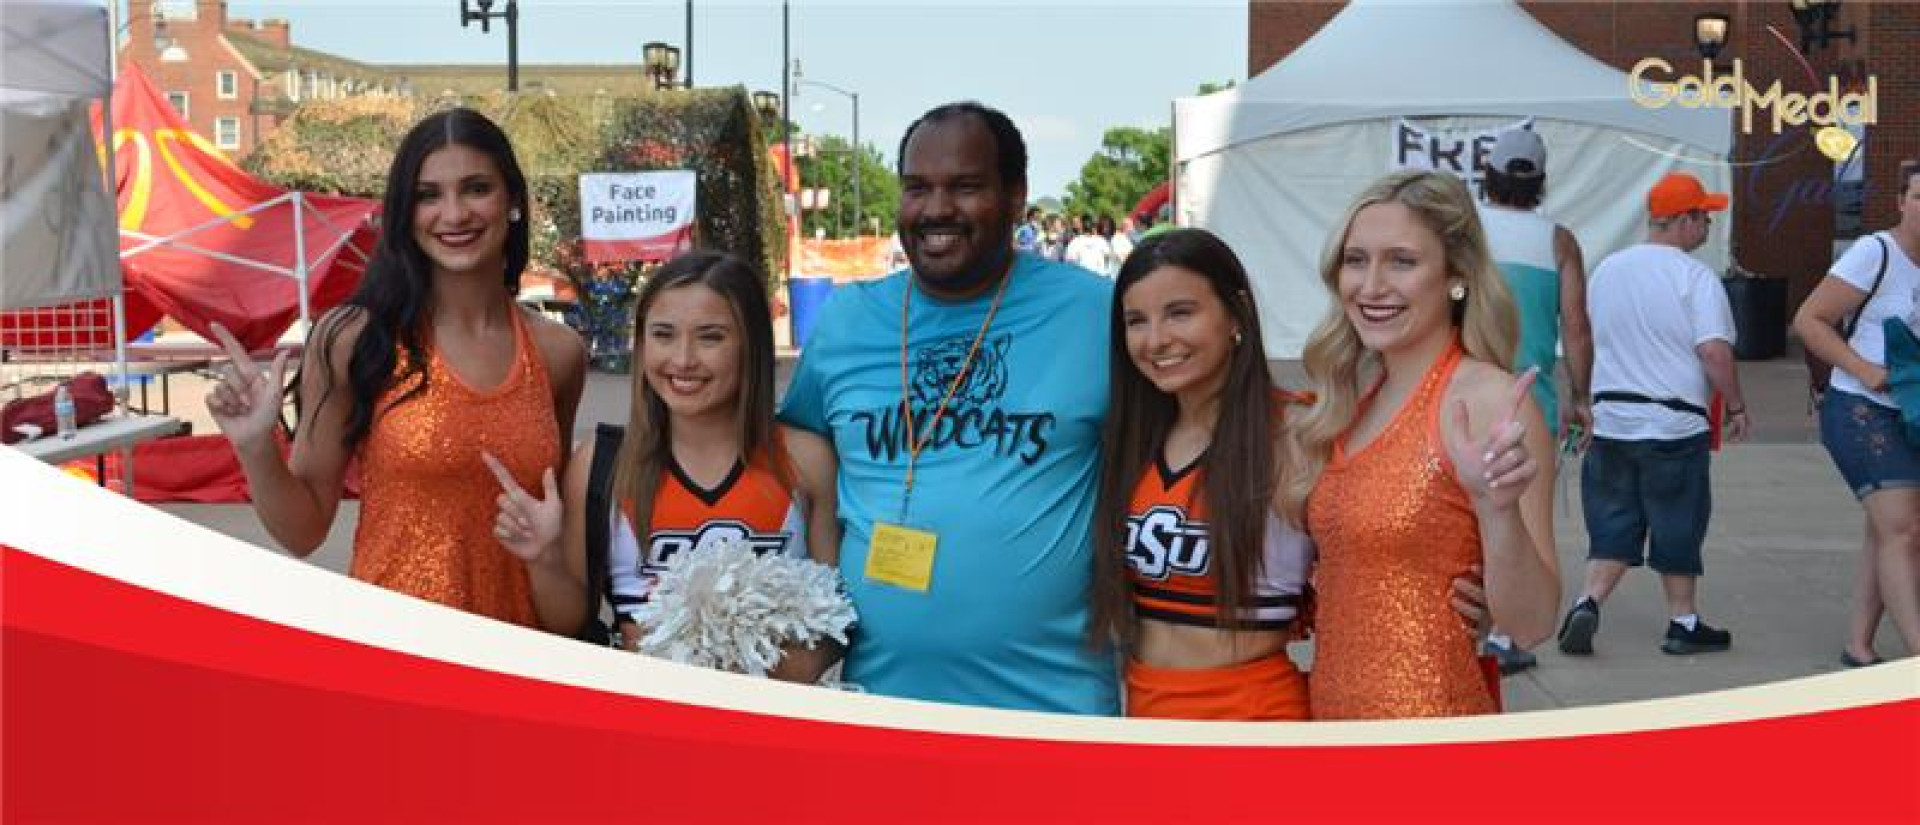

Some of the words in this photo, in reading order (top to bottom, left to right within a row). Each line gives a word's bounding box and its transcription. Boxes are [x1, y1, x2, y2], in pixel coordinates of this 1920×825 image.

[609, 184, 656, 200] Face
[592, 204, 677, 223] Painting
[850, 399, 1056, 465] WILDCATS
